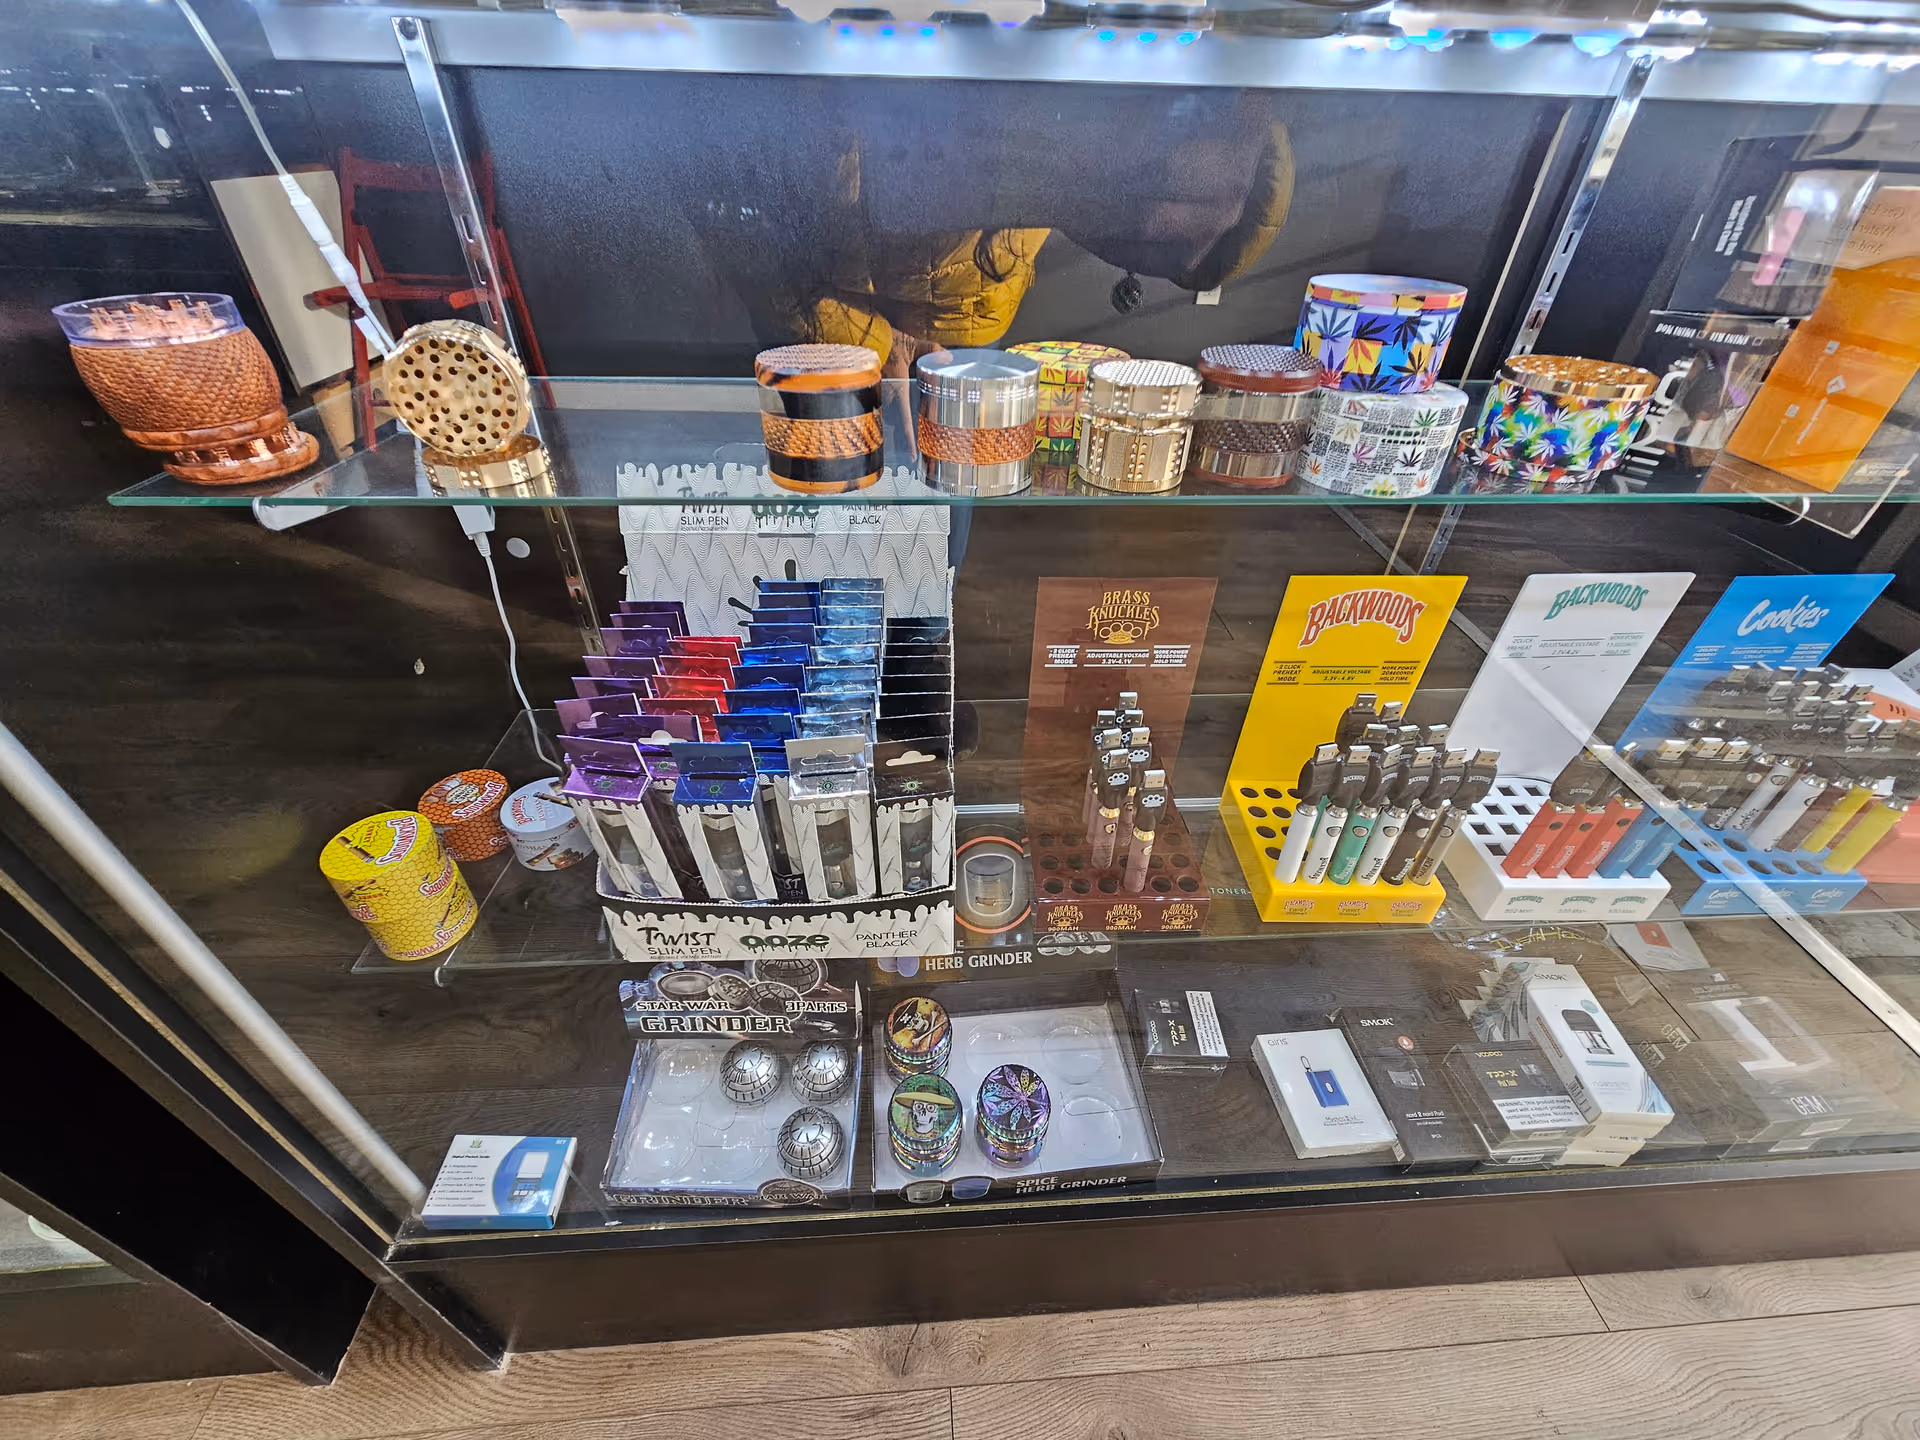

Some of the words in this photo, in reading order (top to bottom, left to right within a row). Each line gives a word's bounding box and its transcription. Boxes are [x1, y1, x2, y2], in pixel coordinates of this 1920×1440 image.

[681, 517, 705, 526] SLIM
[709, 517, 729, 526] PEN
[849, 516, 881, 525] BLACK
[1103, 589, 1152, 606] BRASS
[1543, 582, 1650, 621] BACKWOODS
[1086, 604, 1160, 631] KNUCKLES
[1298, 588, 1428, 649] BACKWOODS
[1737, 595, 1830, 636] Cookies
[1792, 723, 1813, 731] Cookies
[452, 780, 504, 819] BACKWOODS
[375, 815, 419, 866] BACKWOODS
[1114, 904, 1137, 912] BRASS
[1284, 900, 1315, 909] BACKWOODS
[1338, 900, 1369, 910] BACKWOODS
[1391, 901, 1422, 911] BACKWOODS
[1047, 910, 1083, 921] KNUCKLES
[1106, 909, 1142, 921] KNUCKLES
[1161, 909, 1198, 920] KNUCKLES
[637, 927, 716, 946] TWIST
[739, 932, 829, 950] ooze
[856, 930, 918, 941] PANTHER
[866, 939, 909, 948] BLACK
[648, 947, 685, 955] SLIM
[690, 947, 721, 955] PEN
[925, 954, 964, 971] HERB
[968, 951, 1033, 968] GRINDER
[637, 1001, 680, 1012] STAR
[684, 1001, 730, 1011] WAR
[640, 1015, 794, 1034] GRINDER
[1360, 1018, 1392, 1027] SMOK
[1661, 1024, 1688, 1053] GEM
[1790, 1096, 1827, 1115] GEM
[1016, 1176, 1059, 1188] SPICE
[1016, 1183, 1056, 1195] HERB
[1060, 1175, 1127, 1190] GRINDER
[613, 1194, 749, 1206] GRINDER
